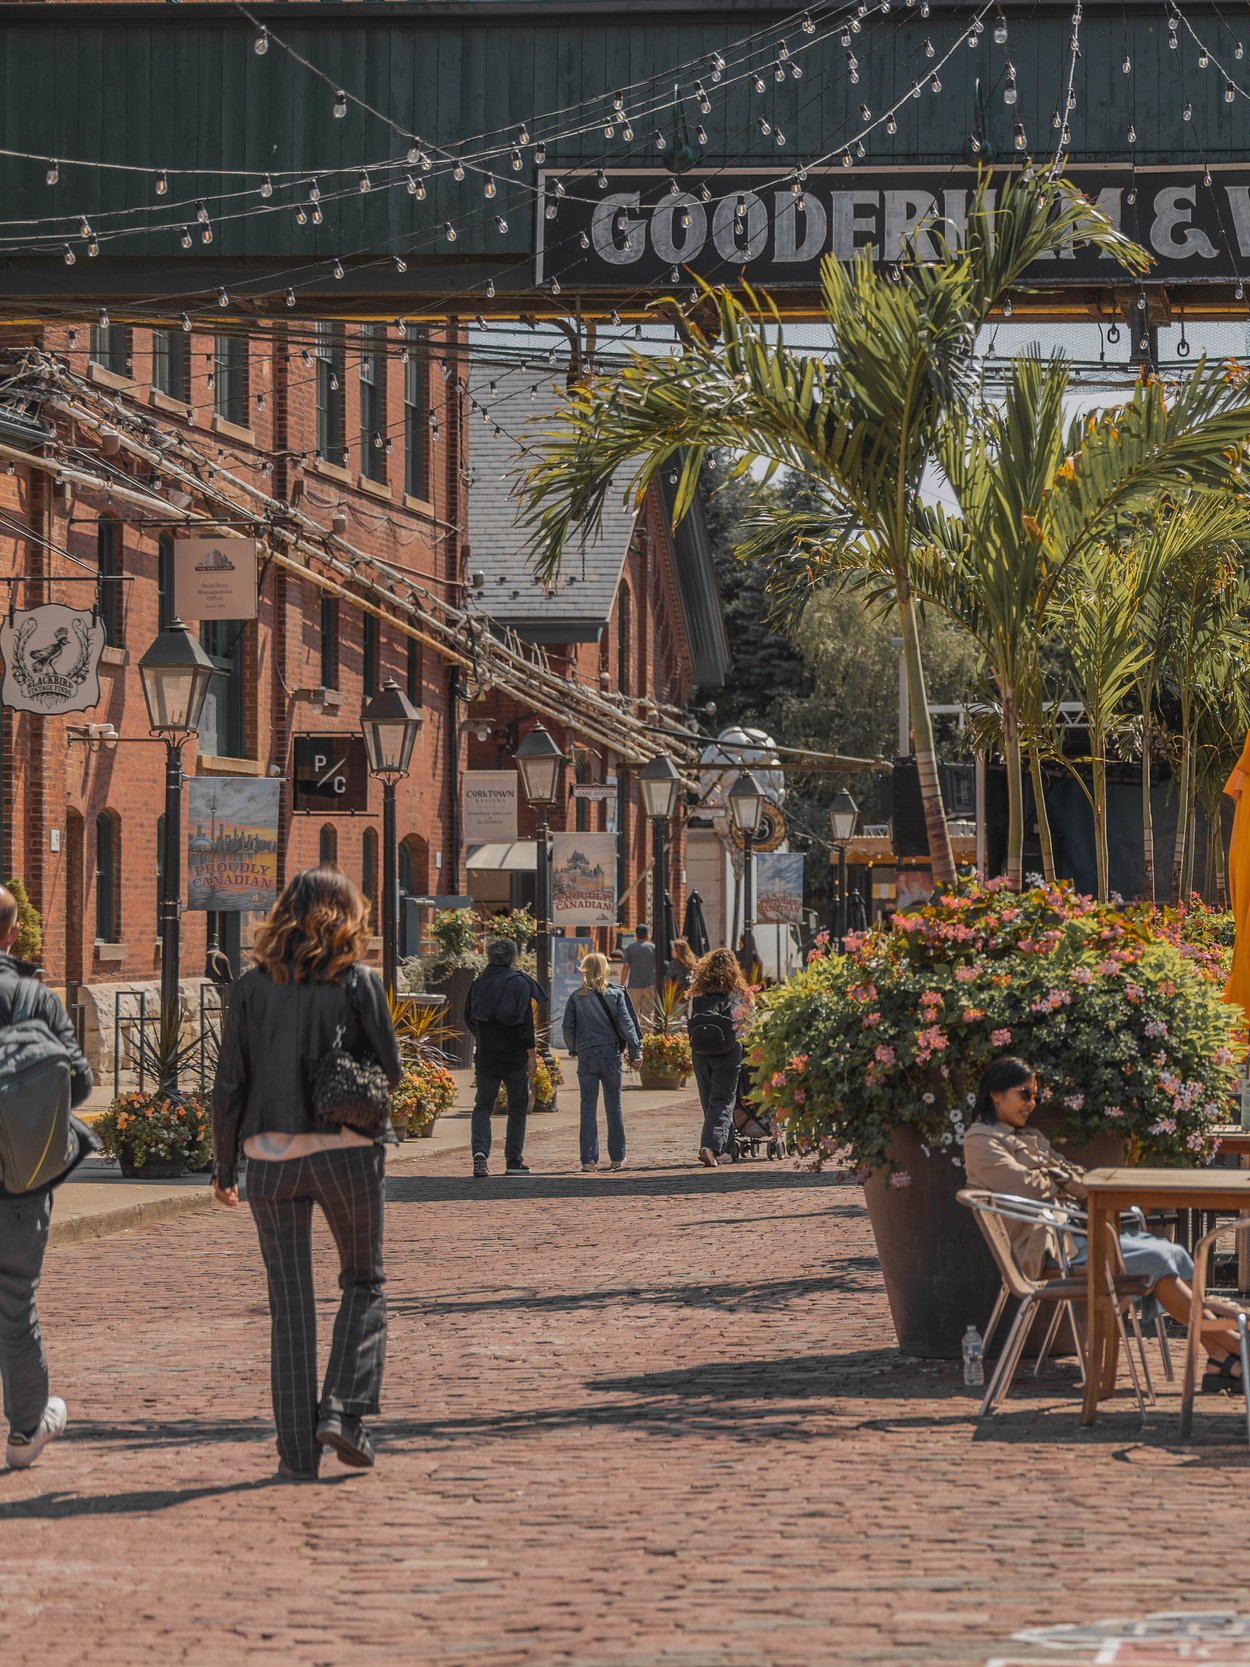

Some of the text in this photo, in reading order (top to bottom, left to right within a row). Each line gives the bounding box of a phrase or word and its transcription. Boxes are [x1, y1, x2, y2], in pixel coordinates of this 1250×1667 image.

[591, 187, 1125, 265] GOODERHM
[1149, 184, 1220, 259] &
[26, 675, 74, 690] BLACKBIRD
[28, 685, 53, 695] VINTAGE
[194, 862, 272, 876] PROUDLY
[192, 874, 273, 888] CANADIAN
[555, 890, 610, 901] PROUDLY
[556, 900, 613, 911] CANADIAN
